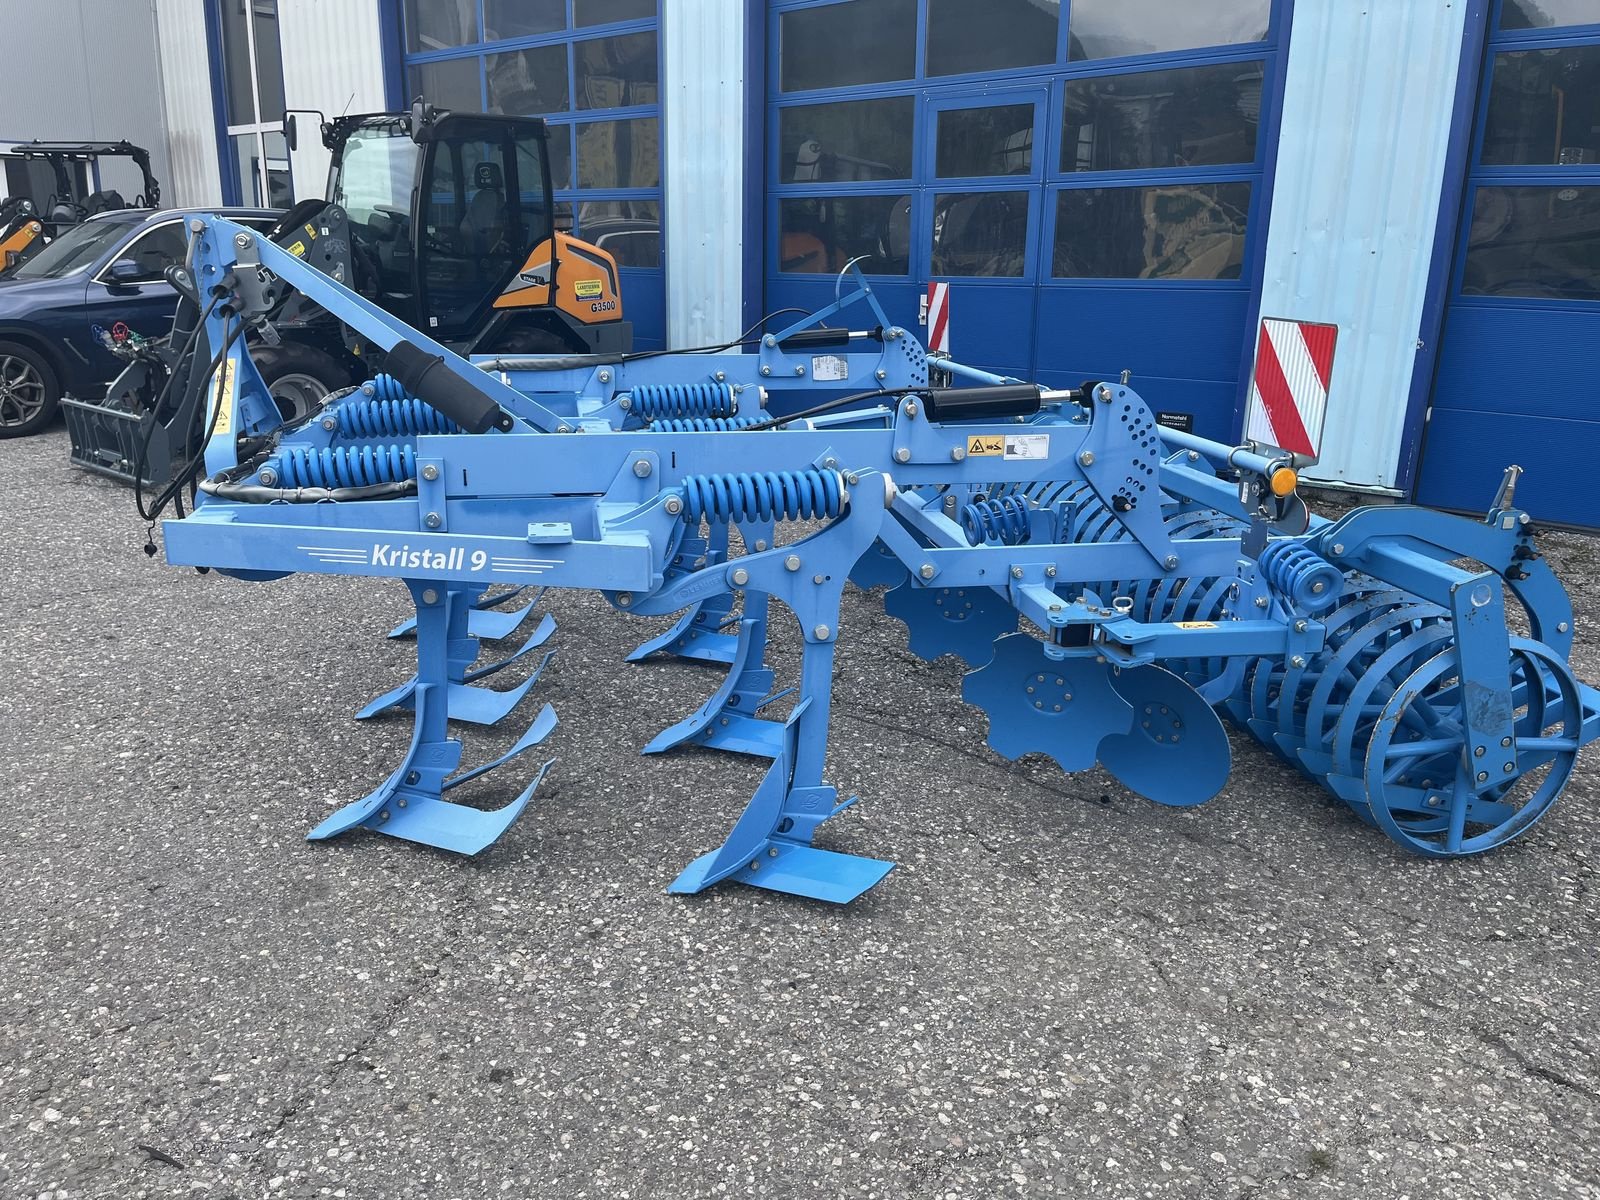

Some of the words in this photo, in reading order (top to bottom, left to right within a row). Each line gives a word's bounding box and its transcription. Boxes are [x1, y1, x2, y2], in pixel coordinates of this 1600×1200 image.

[591, 301, 616, 312] G3500
[371, 543, 465, 570] Kristall
[470, 550, 487, 571] 9
